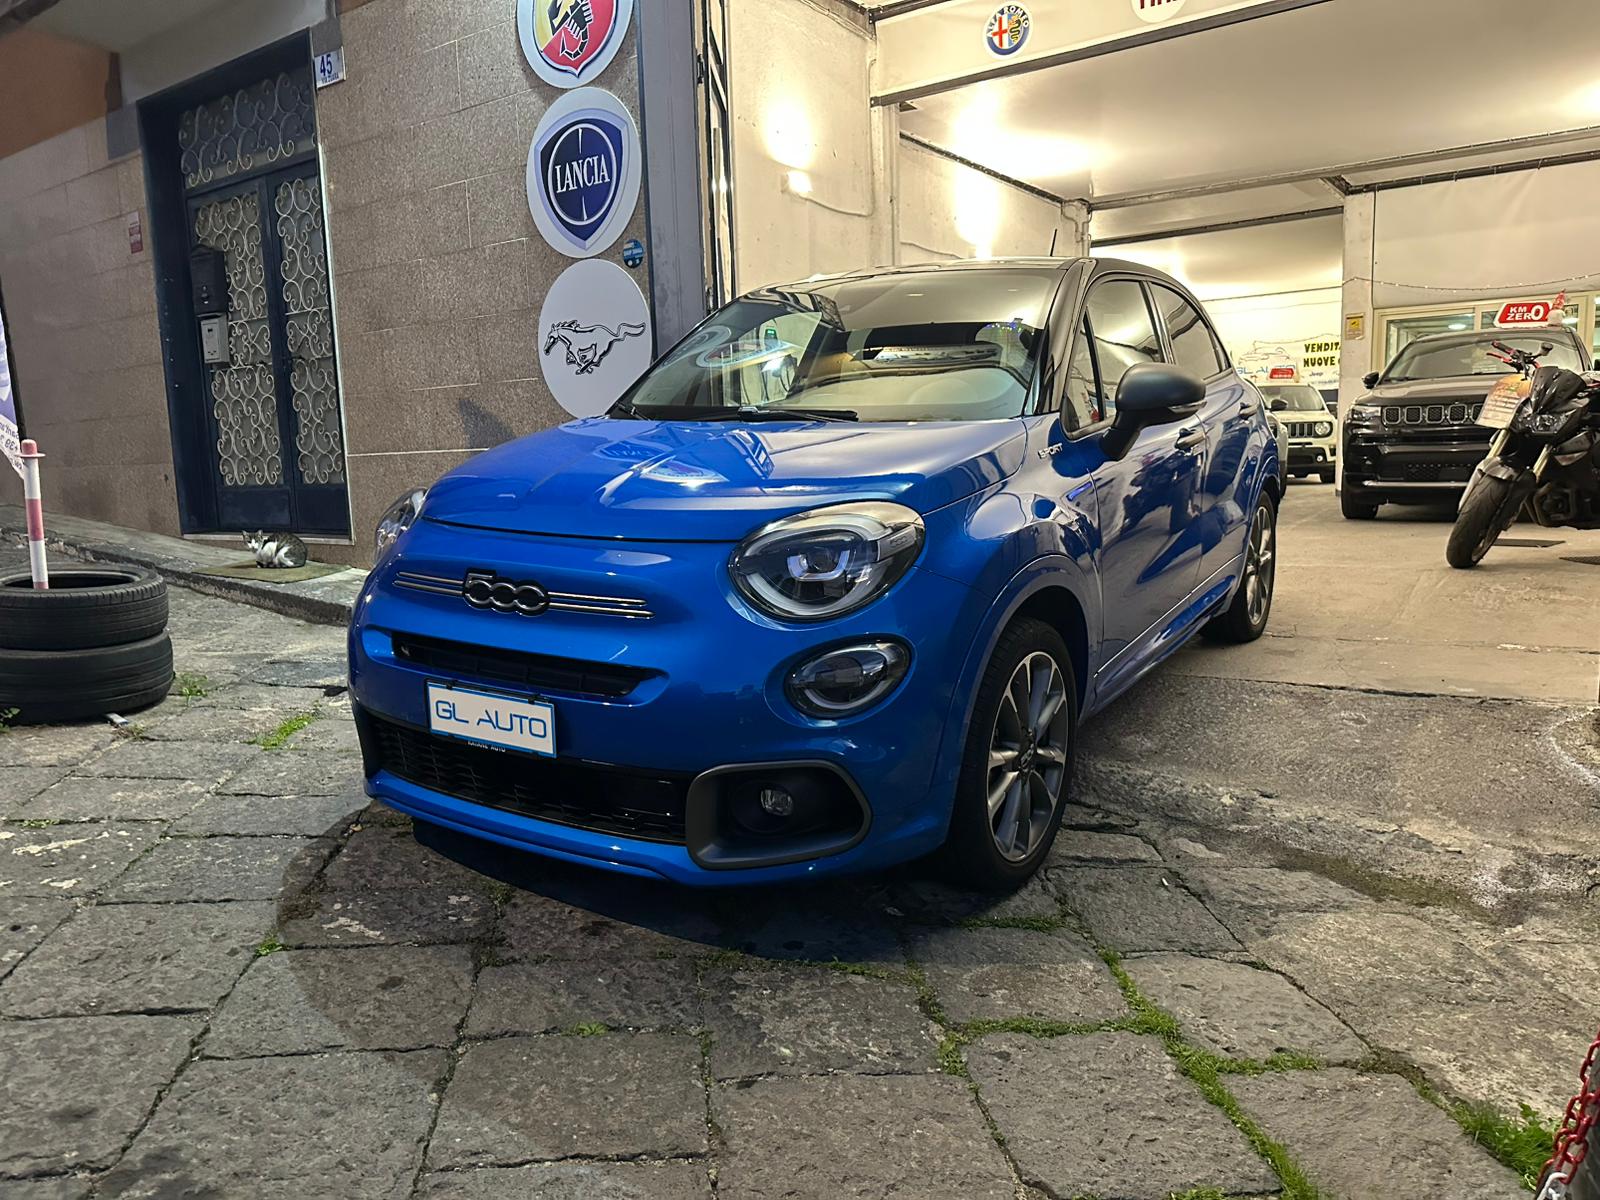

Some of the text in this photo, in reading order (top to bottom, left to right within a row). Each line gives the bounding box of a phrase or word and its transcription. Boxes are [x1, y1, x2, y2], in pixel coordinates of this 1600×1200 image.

[1003, 5, 1029, 28] ROMEO
[320, 54, 332, 76] 45
[555, 154, 610, 193] LANCIA
[1304, 341, 1340, 353] VENDIT
[1303, 356, 1335, 367] NUOVE
[1038, 442, 1063, 459] SPORT
[465, 572, 546, 611] 500
[435, 700, 547, 738] GL AUTO
